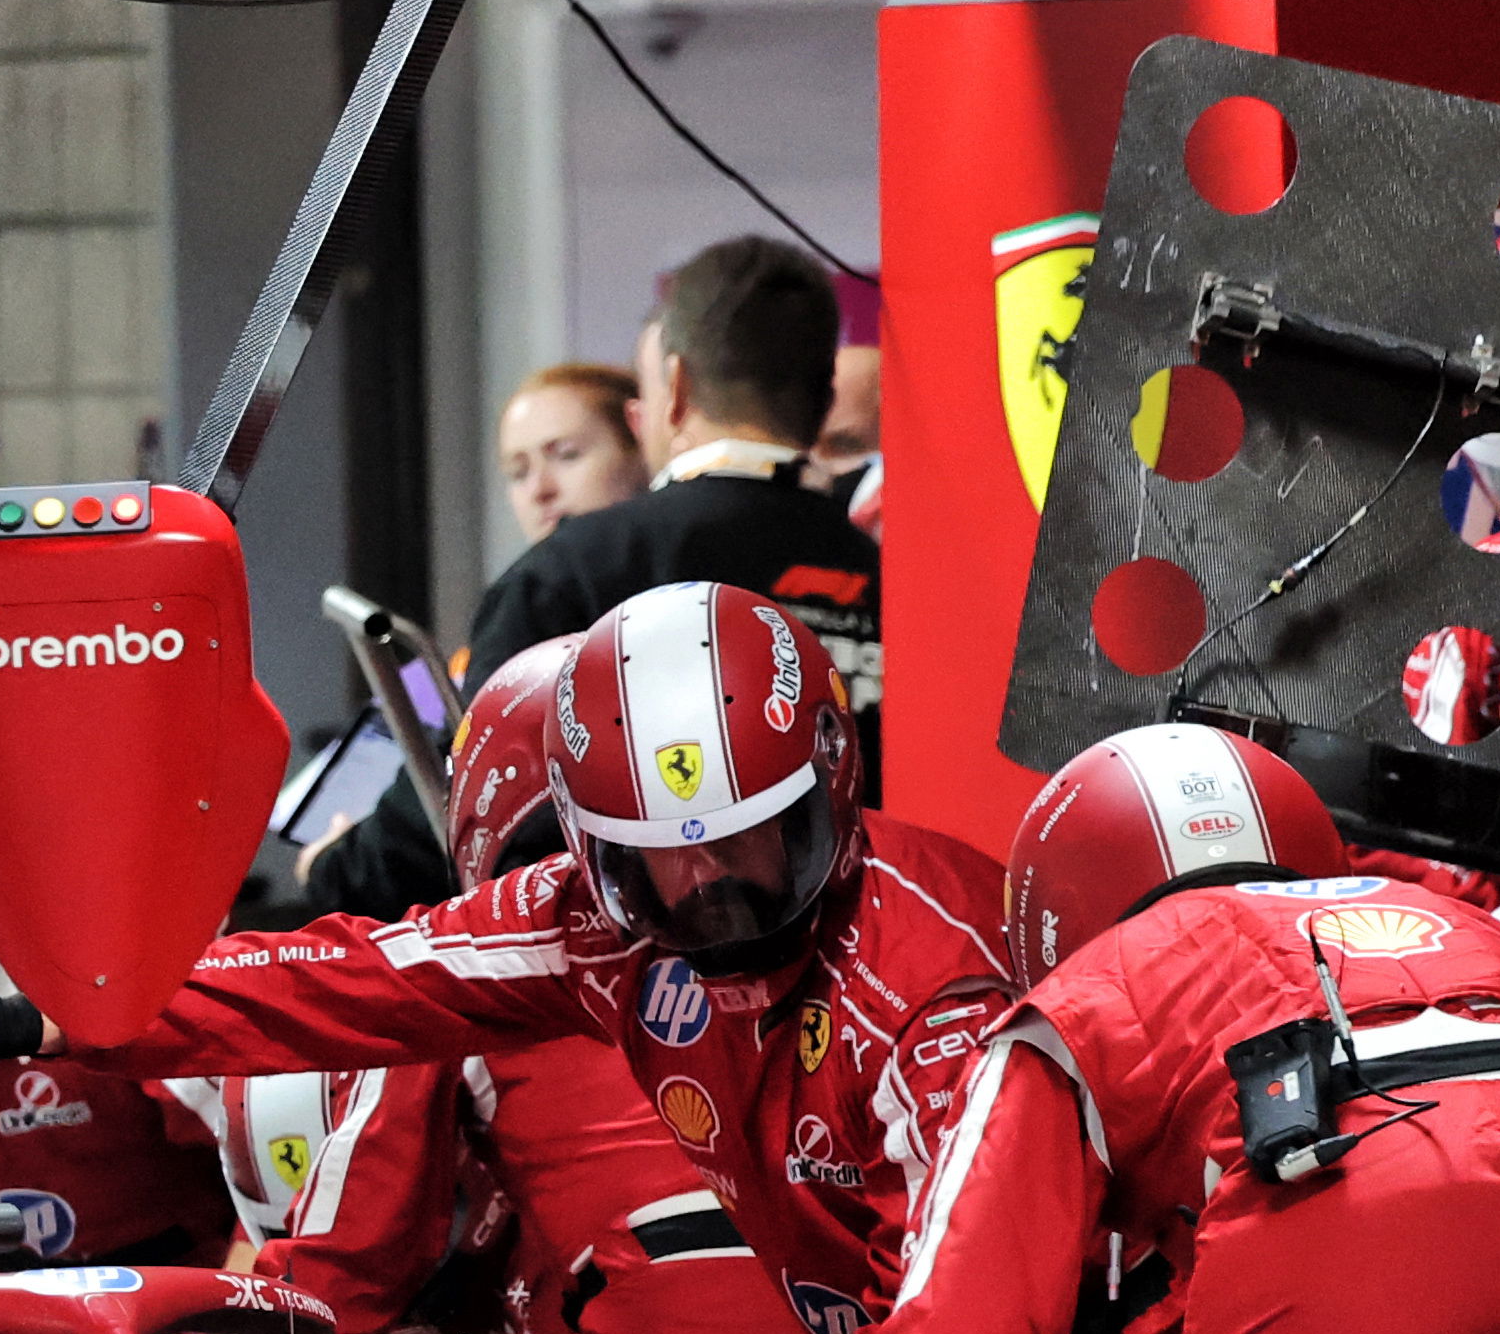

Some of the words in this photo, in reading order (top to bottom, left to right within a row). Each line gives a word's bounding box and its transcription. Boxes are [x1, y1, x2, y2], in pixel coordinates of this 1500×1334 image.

[753, 607, 800, 703] UniCredit
[1180, 778, 1217, 797] DOT
[682, 819, 705, 841] hp
[1188, 817, 1238, 834] BELL
[193, 948, 271, 972] CHARD
[278, 943, 346, 964] MILLE
[645, 958, 706, 1047] hp
[215, 1273, 275, 1311] DXC
